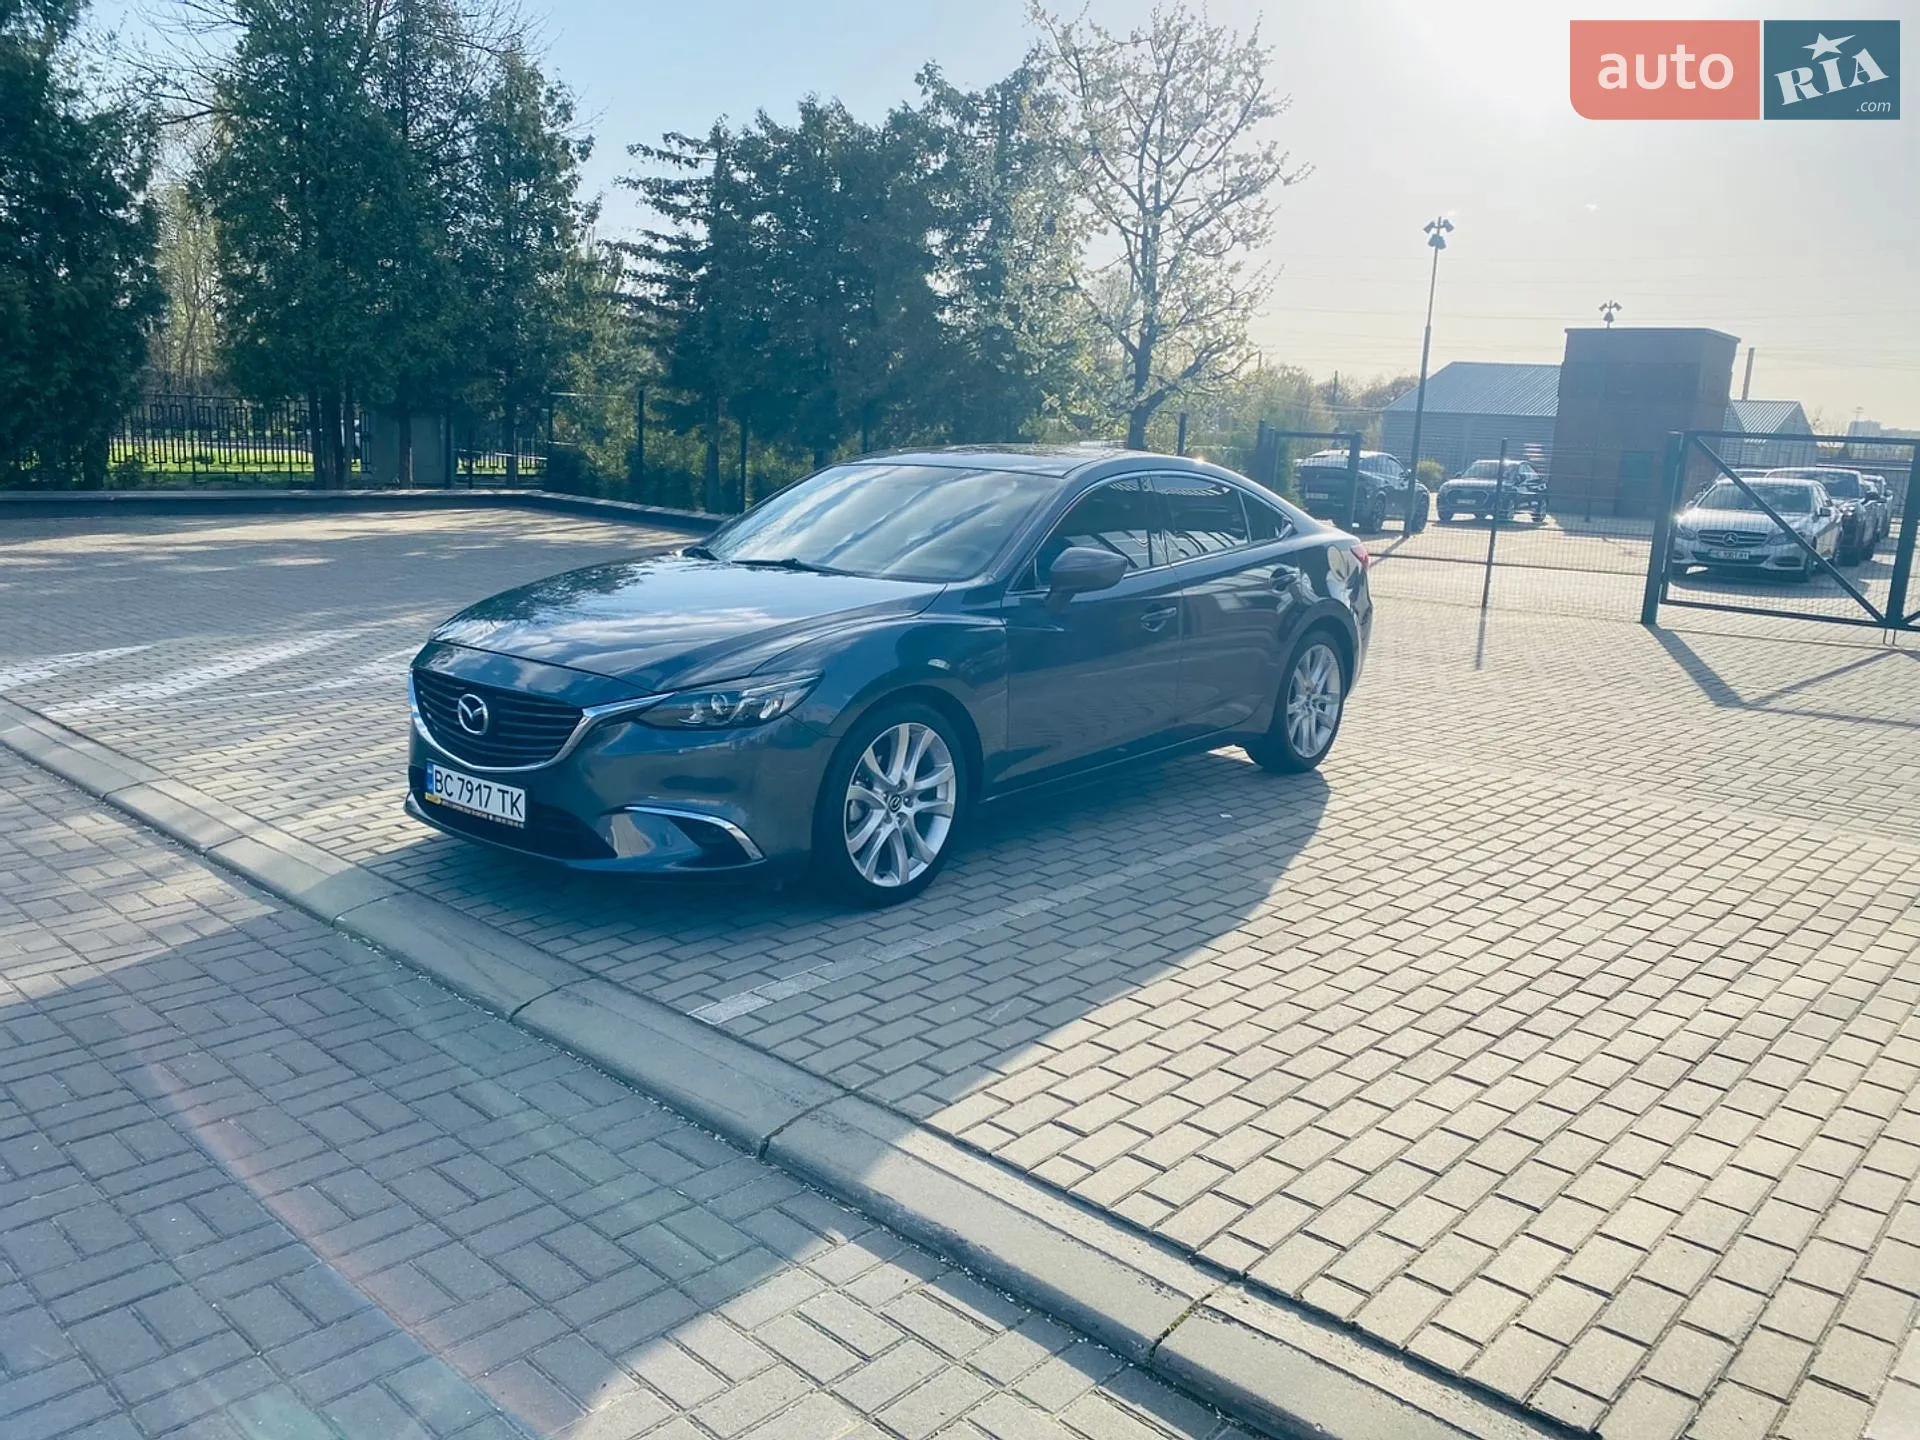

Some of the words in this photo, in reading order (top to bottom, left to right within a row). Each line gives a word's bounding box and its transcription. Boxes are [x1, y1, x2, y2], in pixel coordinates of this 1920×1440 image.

[434, 770, 454, 797] BC
[457, 777, 492, 808] 7917
[496, 788, 523, 818] TK
